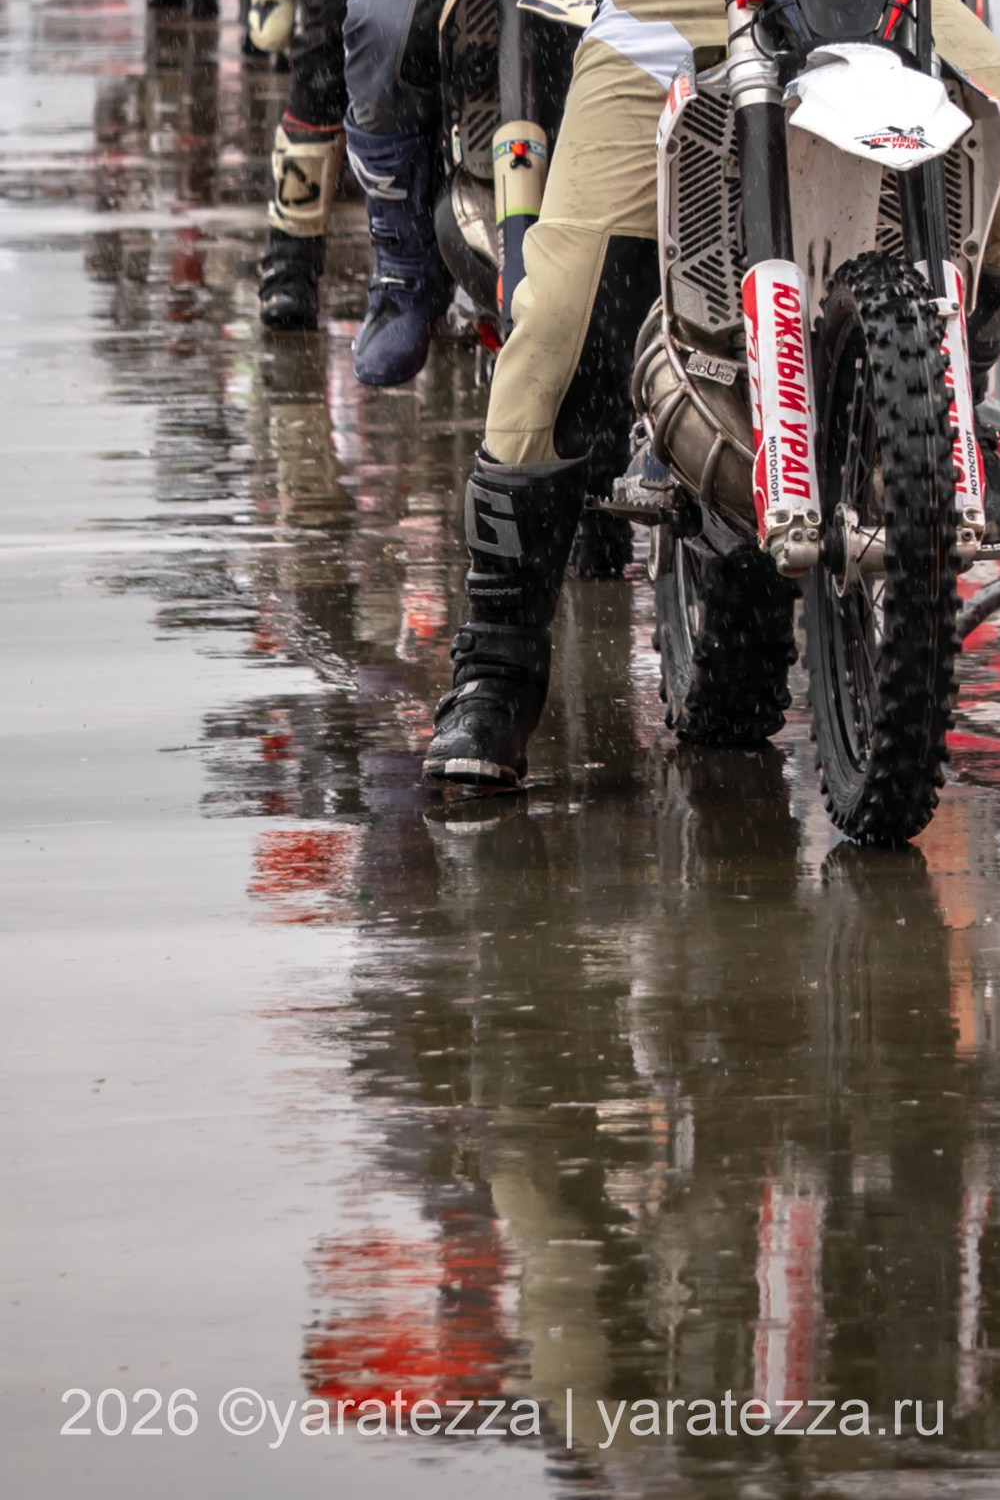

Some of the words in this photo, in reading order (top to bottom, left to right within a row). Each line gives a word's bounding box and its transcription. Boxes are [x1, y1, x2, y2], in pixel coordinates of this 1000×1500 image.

[772, 282, 813, 415] ЮЖНЫЙ
[768, 436, 779, 503] МОТОСПОРТ
[780, 419, 812, 501] УРАЛ
[965, 430, 978, 496] МОТОСПОРТ
